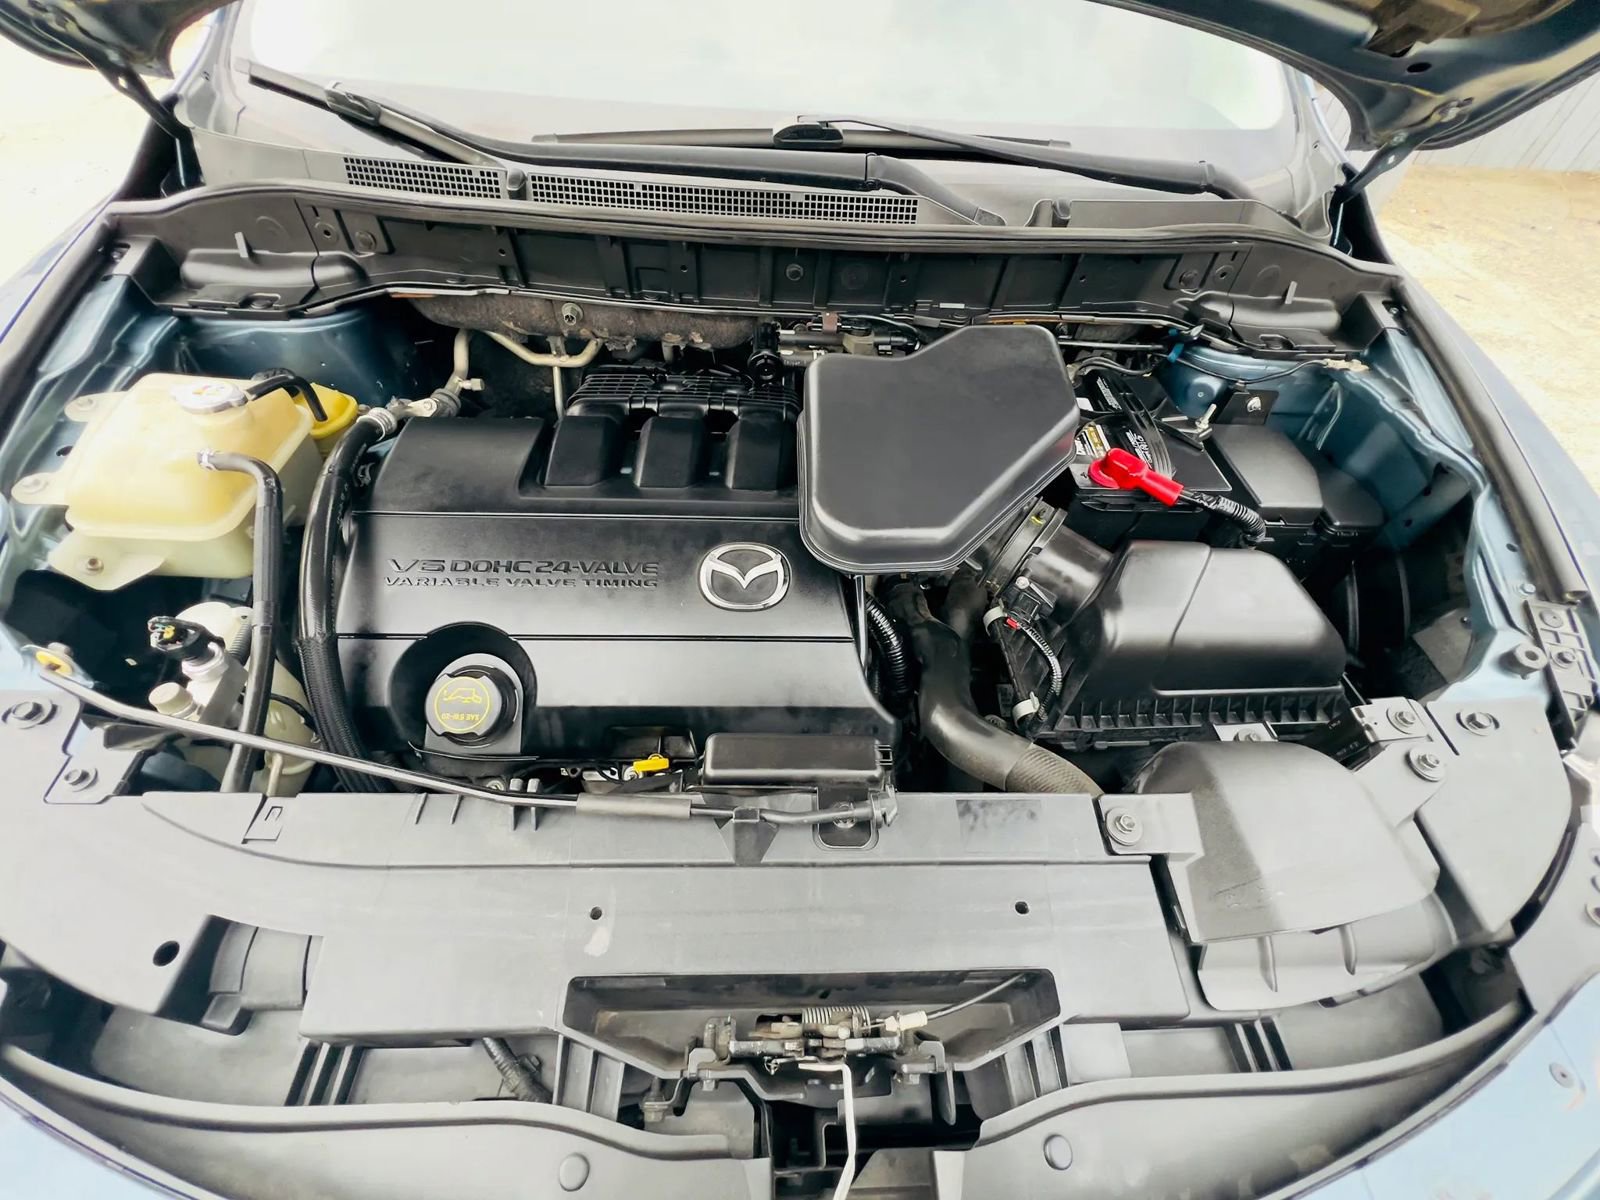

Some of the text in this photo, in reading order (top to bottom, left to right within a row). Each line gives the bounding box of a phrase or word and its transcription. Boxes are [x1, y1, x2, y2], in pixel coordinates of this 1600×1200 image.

[388, 559, 660, 576] V6 DOHC 24-VALVE
[384, 577, 659, 588] VARIABLE VALVE TIMING
